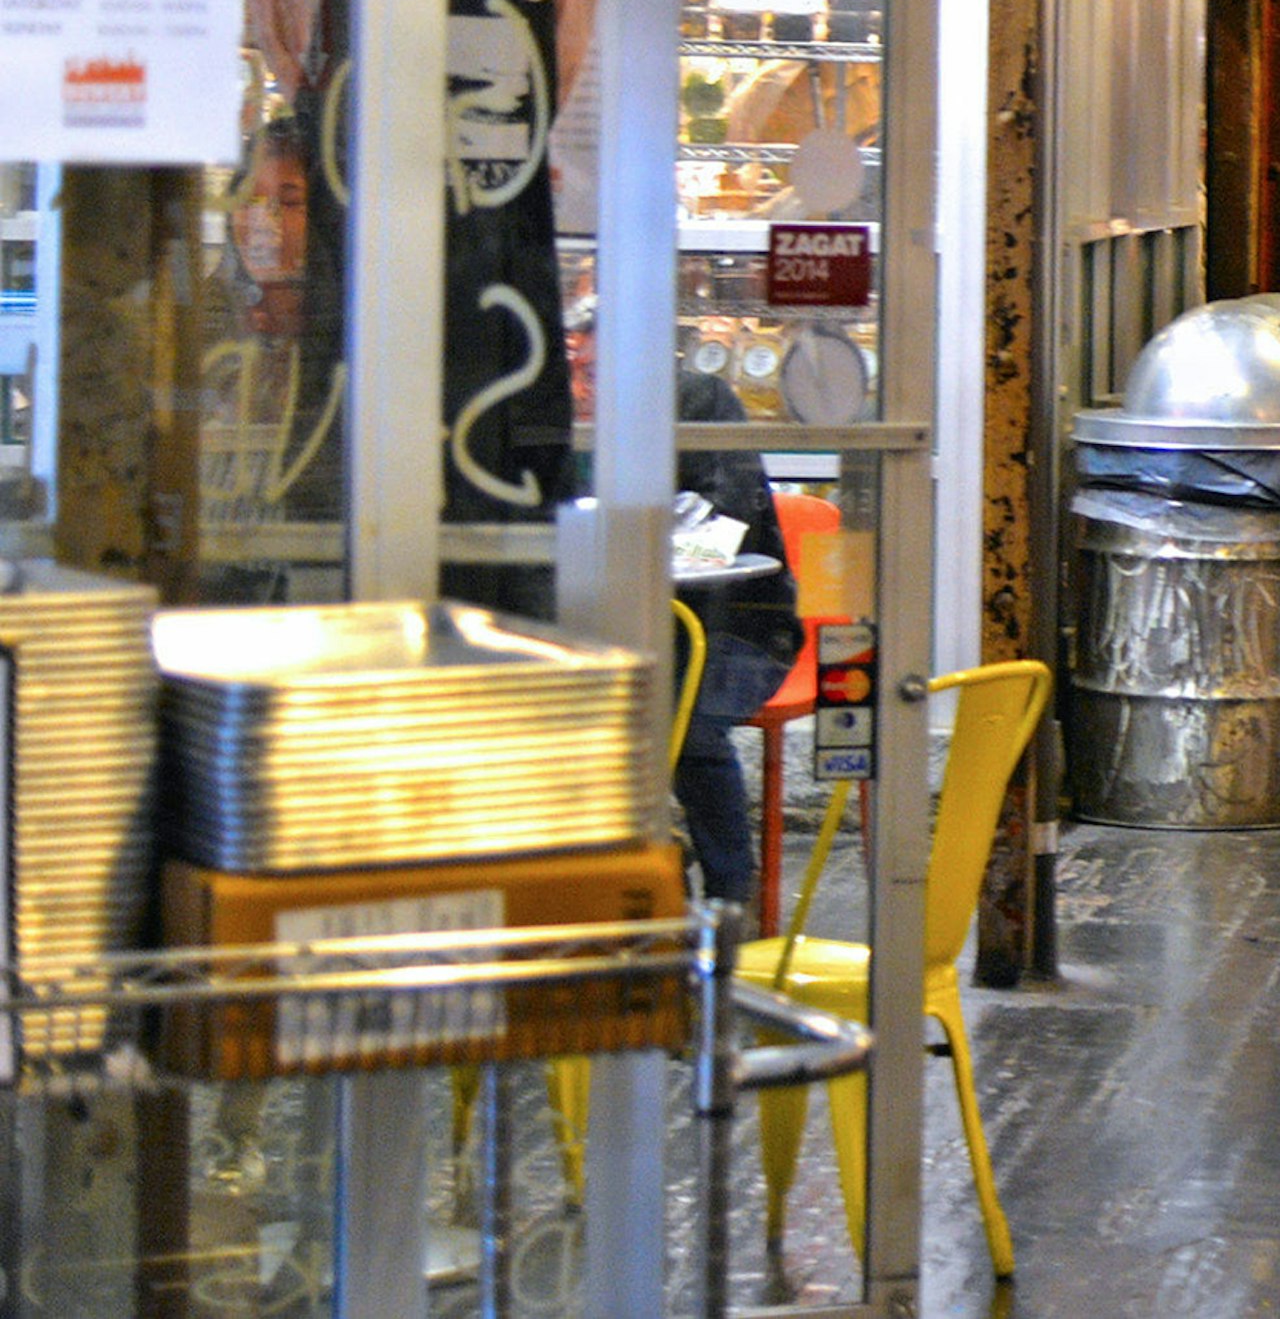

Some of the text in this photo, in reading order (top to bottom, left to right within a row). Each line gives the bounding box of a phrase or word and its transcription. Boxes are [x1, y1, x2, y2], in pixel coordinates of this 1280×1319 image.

[776, 232, 863, 256] ZAGAT
[775, 259, 830, 282] 2014
[823, 754, 867, 772] VISA
